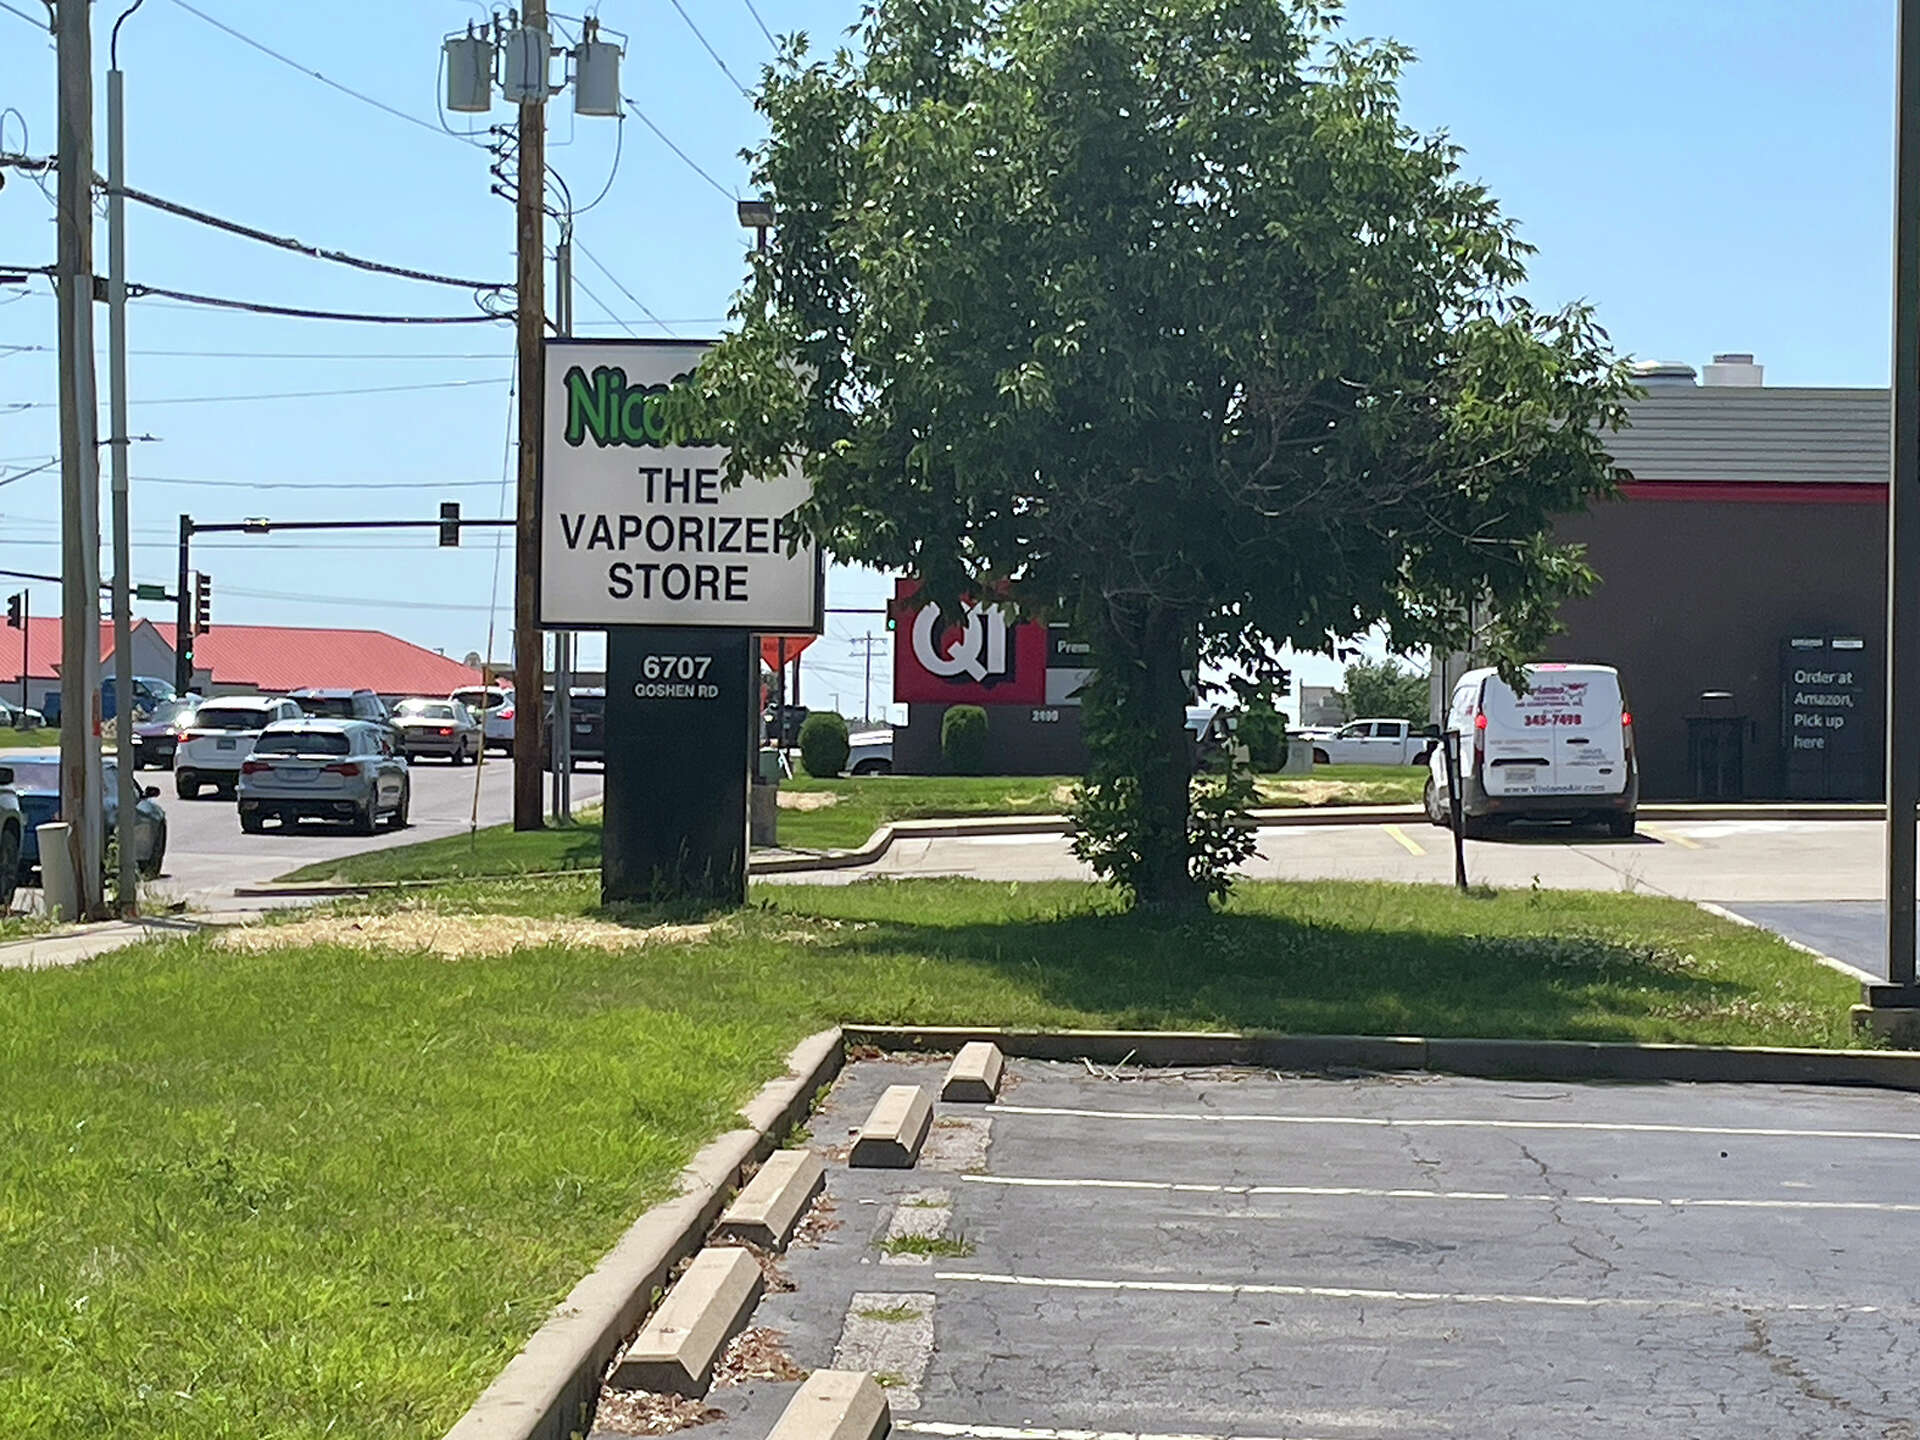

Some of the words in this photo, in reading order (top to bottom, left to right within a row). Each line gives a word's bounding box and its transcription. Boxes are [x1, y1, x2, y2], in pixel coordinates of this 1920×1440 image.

[638, 467, 719, 504] THE
[608, 562, 749, 602] STORE
[643, 655, 712, 679] 6707
[1794, 670, 1835, 684] Order
[1838, 671, 1854, 684] at
[634, 683, 696, 697] GOSHEN
[697, 684, 719, 698] RD
[1793, 691, 1854, 707] Amazon,
[1794, 713, 1822, 727] Pick
[1825, 715, 1844, 729] up
[1793, 735, 1825, 749] here
